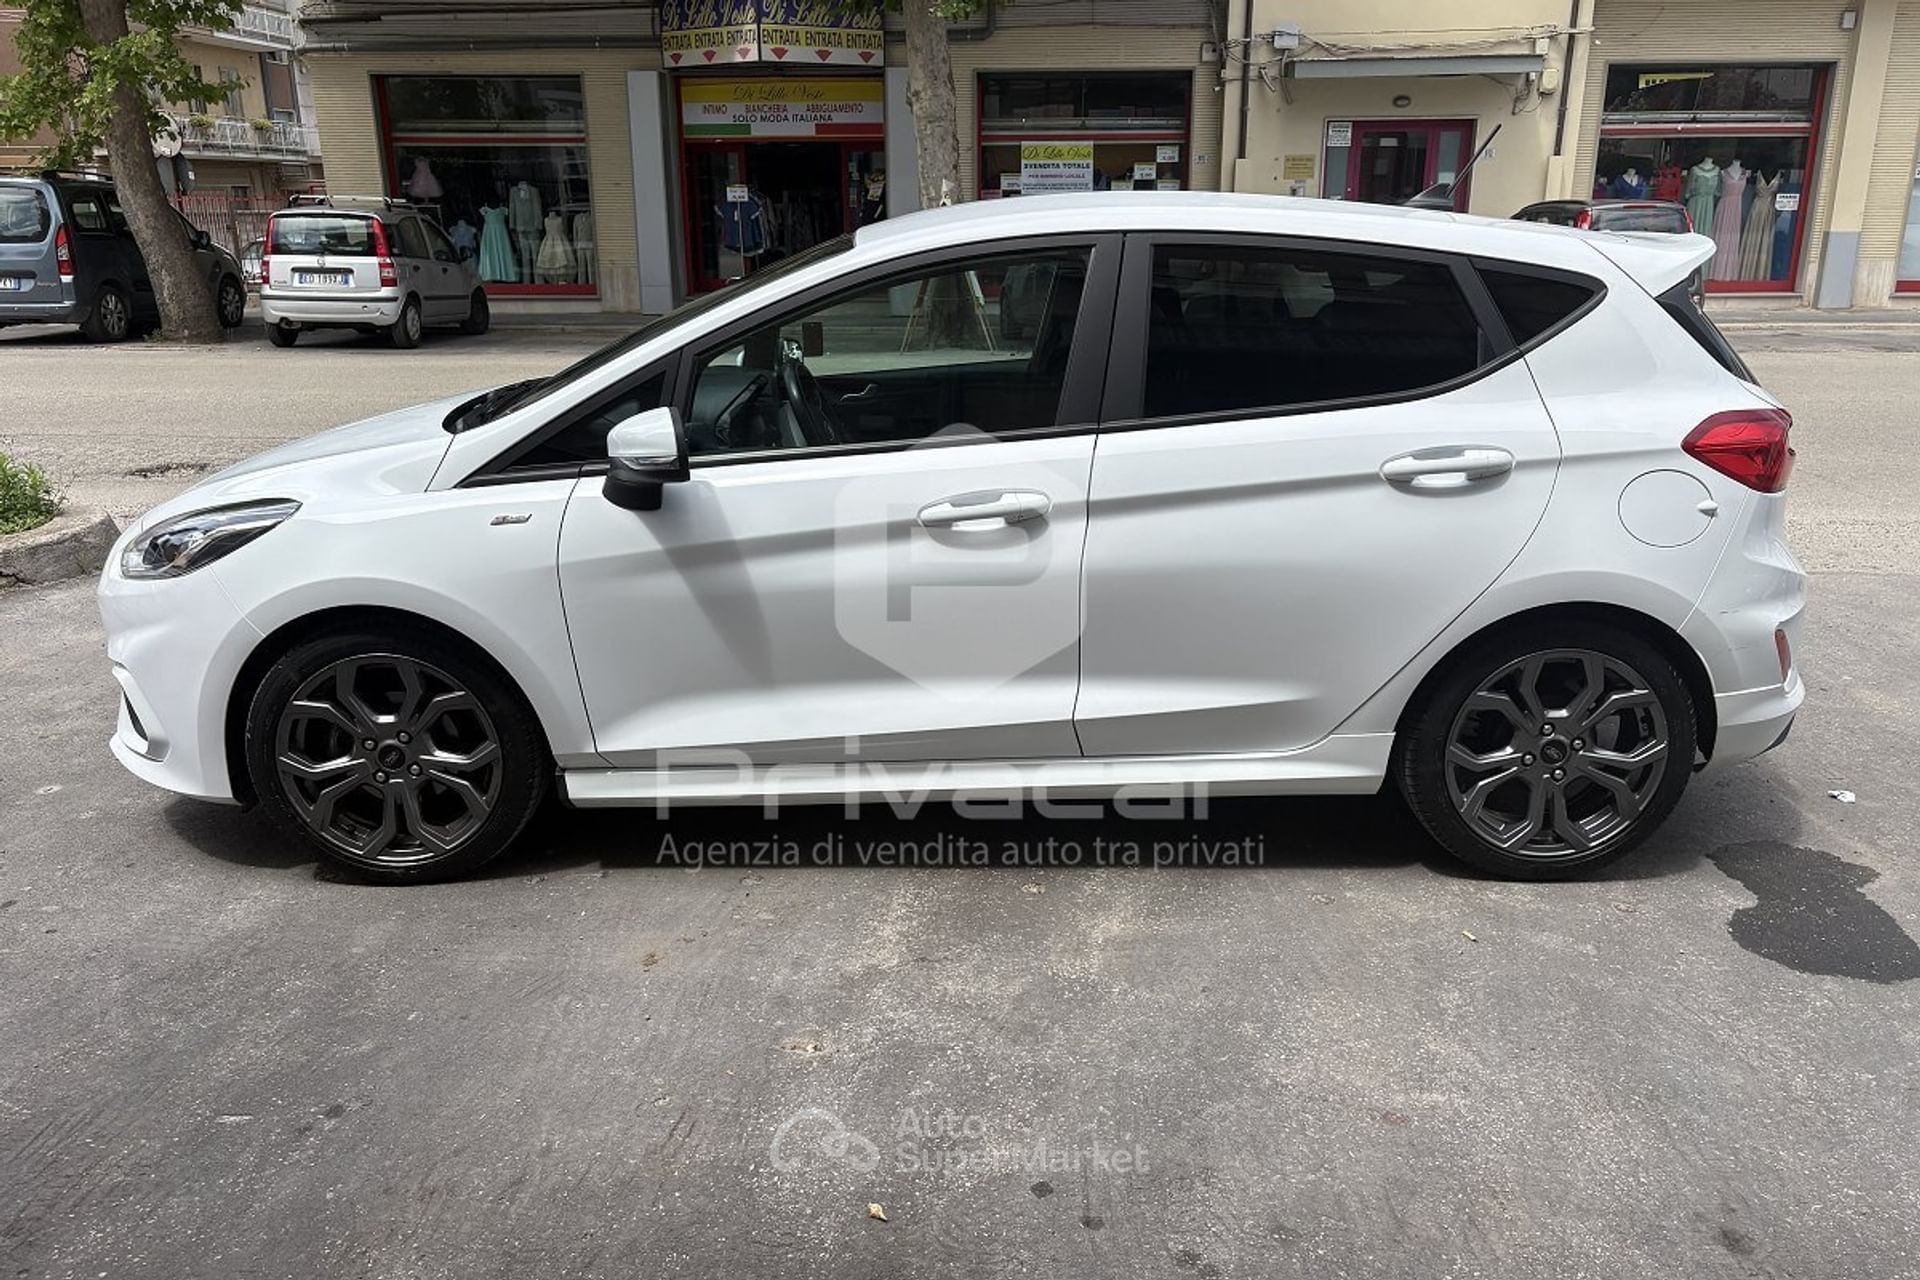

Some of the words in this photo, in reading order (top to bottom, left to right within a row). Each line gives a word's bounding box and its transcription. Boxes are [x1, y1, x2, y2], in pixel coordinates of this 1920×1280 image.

[663, 35, 692, 52] ENTRATA
[694, 31, 725, 48] ENTRATA
[727, 28, 757, 46] ENTRATA
[762, 28, 801, 46] ENTRATA
[805, 30, 843, 48] ENTRATA
[846, 33, 883, 49] ENTRATA
[703, 104, 728, 115] INTIMO
[745, 104, 789, 114] BIANCHERIA
[805, 103, 864, 113] ABBIGLIAMENTO
[732, 114, 757, 123] SOLO
[760, 114, 789, 123] MODA
[792, 114, 833, 123] ITALIANA
[1023, 162, 1060, 170] SVENDITA
[1063, 162, 1091, 170] TOTALE
